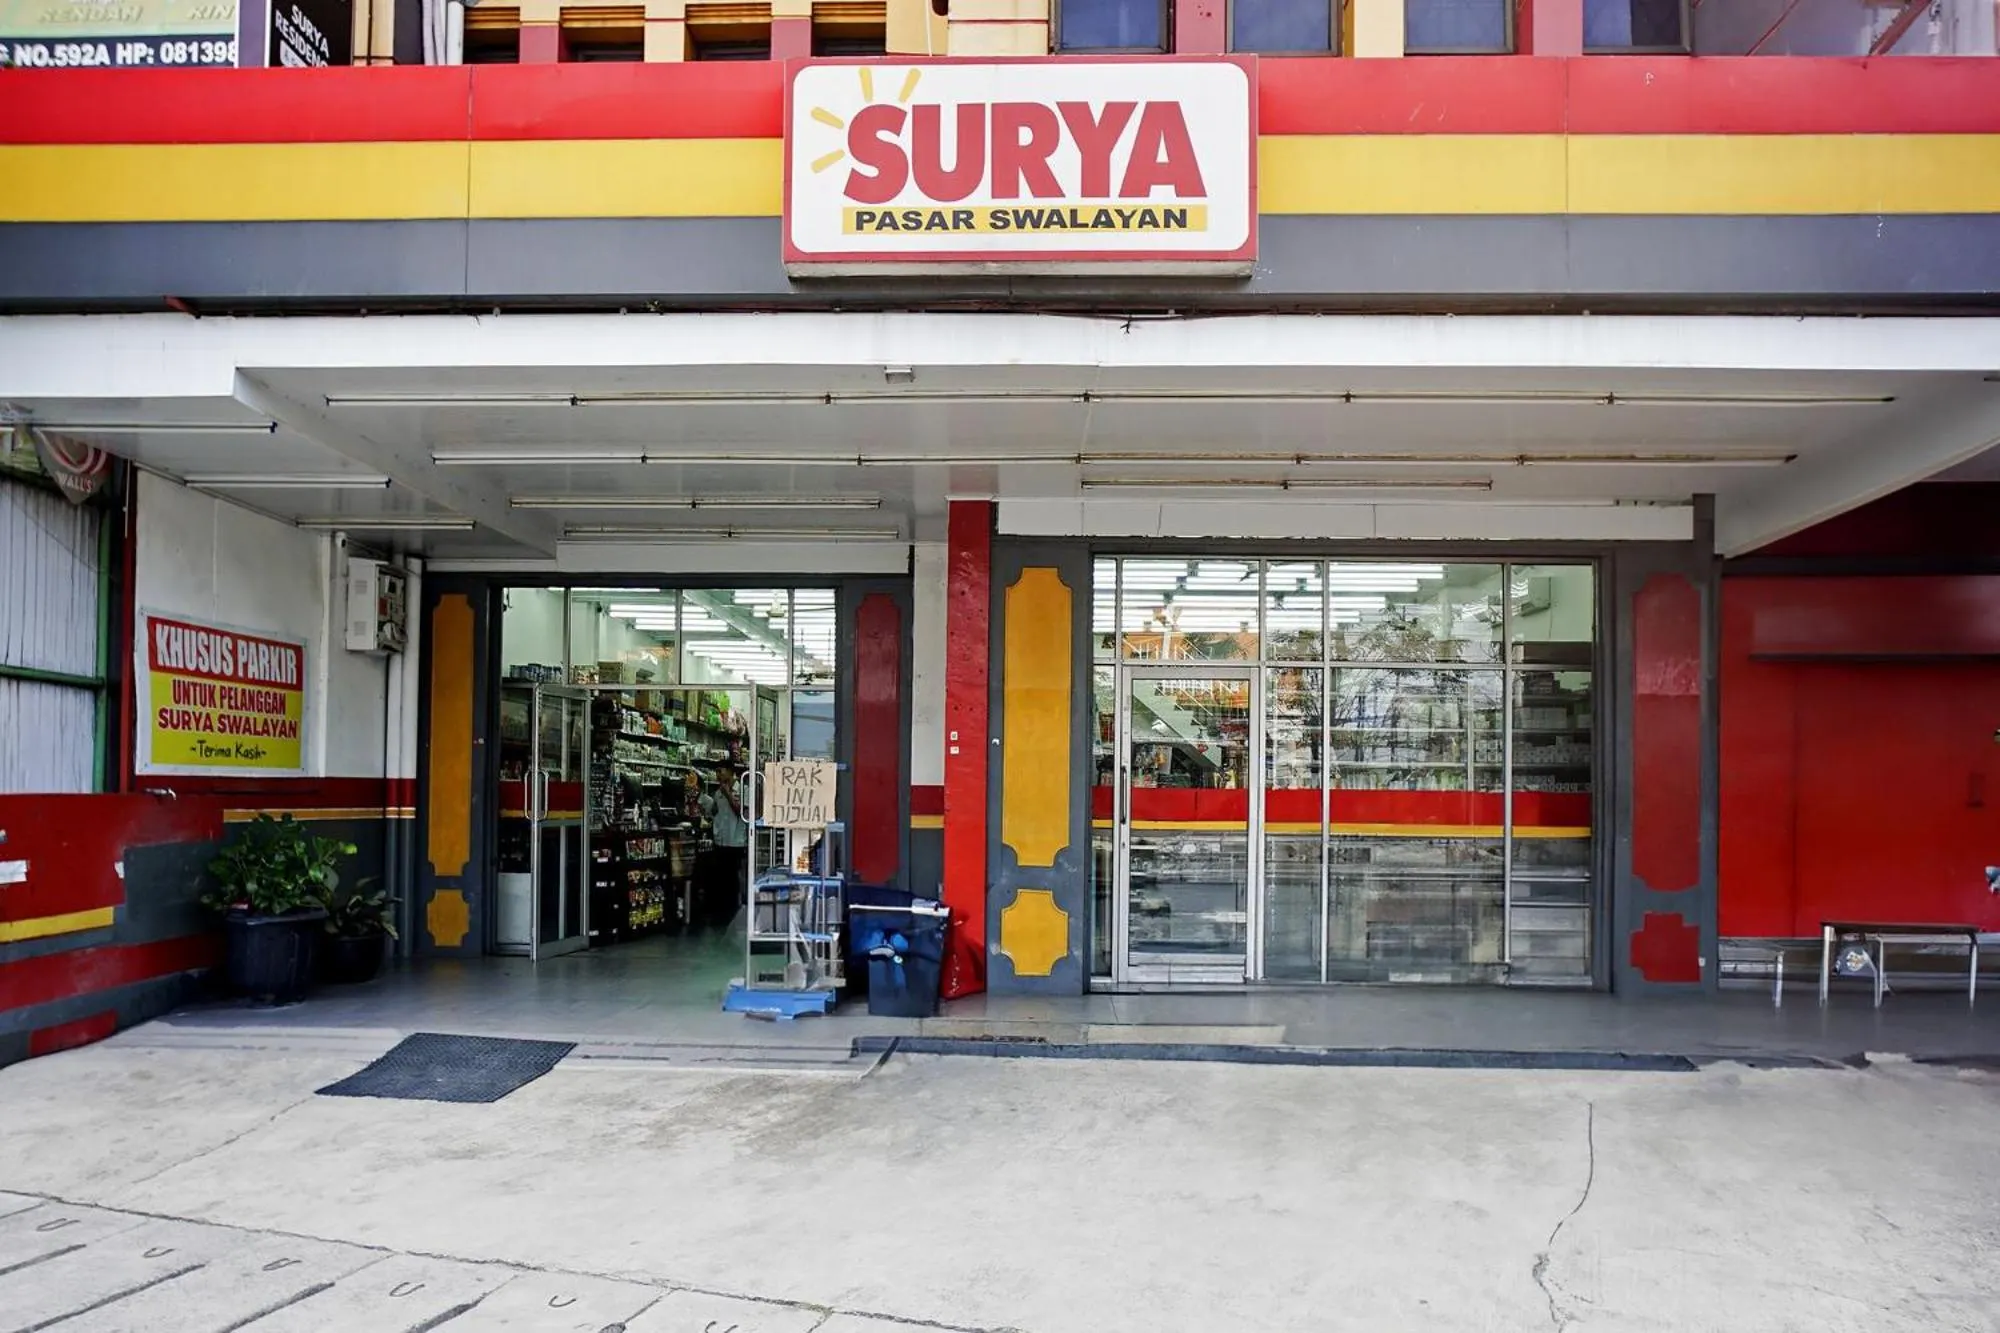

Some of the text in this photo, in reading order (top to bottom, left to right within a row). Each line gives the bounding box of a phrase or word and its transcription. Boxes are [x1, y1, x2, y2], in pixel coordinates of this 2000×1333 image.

[291, 4, 330, 59] SURYA
[14, 42, 111, 67] NO.592A
[116, 42, 155, 65] HP:
[843, 101, 1208, 204] SURYA
[855, 208, 1188, 231] PASAR SWALAYAN
[155, 622, 297, 685] KHUSUS PARKIR
[172, 678, 286, 716] UNTUK PELANGGAN
[158, 707, 297, 739] SURYA SWALAYAN
[782, 766, 823, 786] RAK
[787, 787, 814, 806] INI
